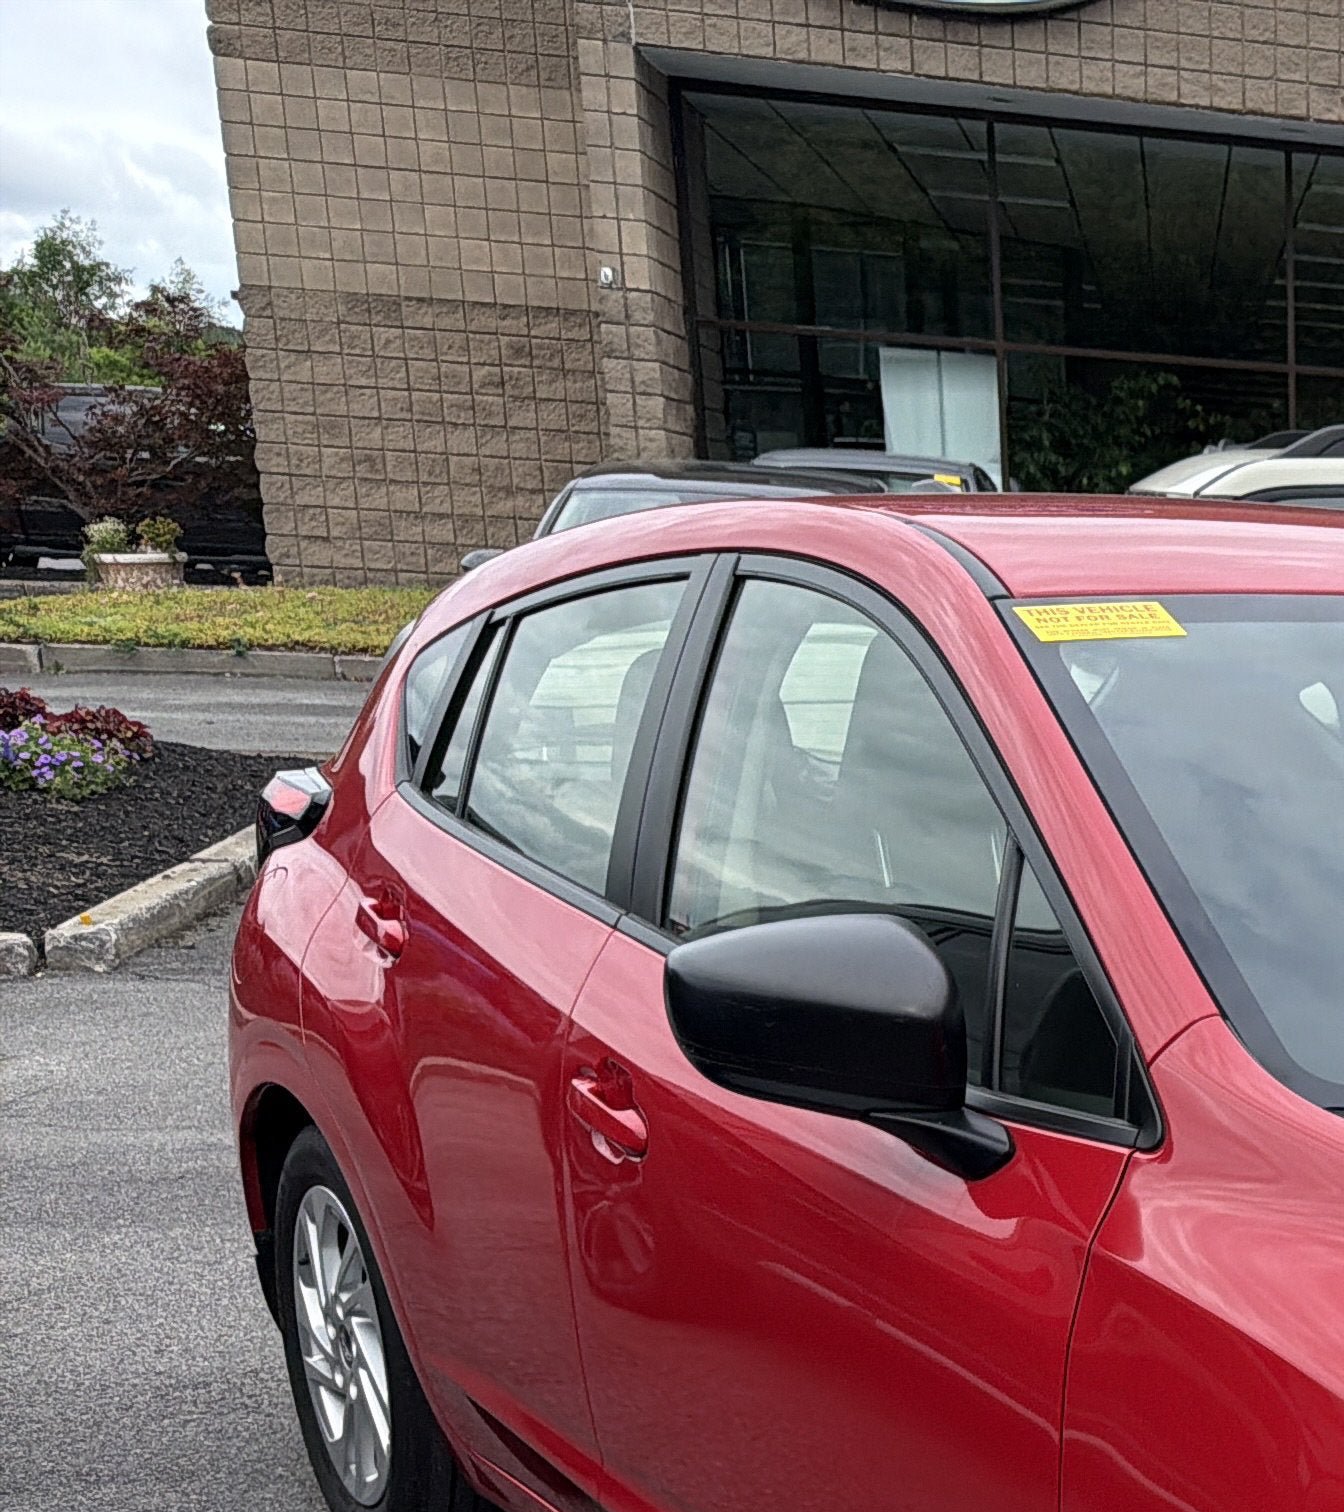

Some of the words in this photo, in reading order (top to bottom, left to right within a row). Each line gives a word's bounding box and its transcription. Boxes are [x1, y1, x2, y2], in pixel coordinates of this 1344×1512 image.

[1023, 608, 1070, 616] THIS
[1072, 604, 1158, 614] VEHICLE
[1035, 616, 1069, 624] NOT
